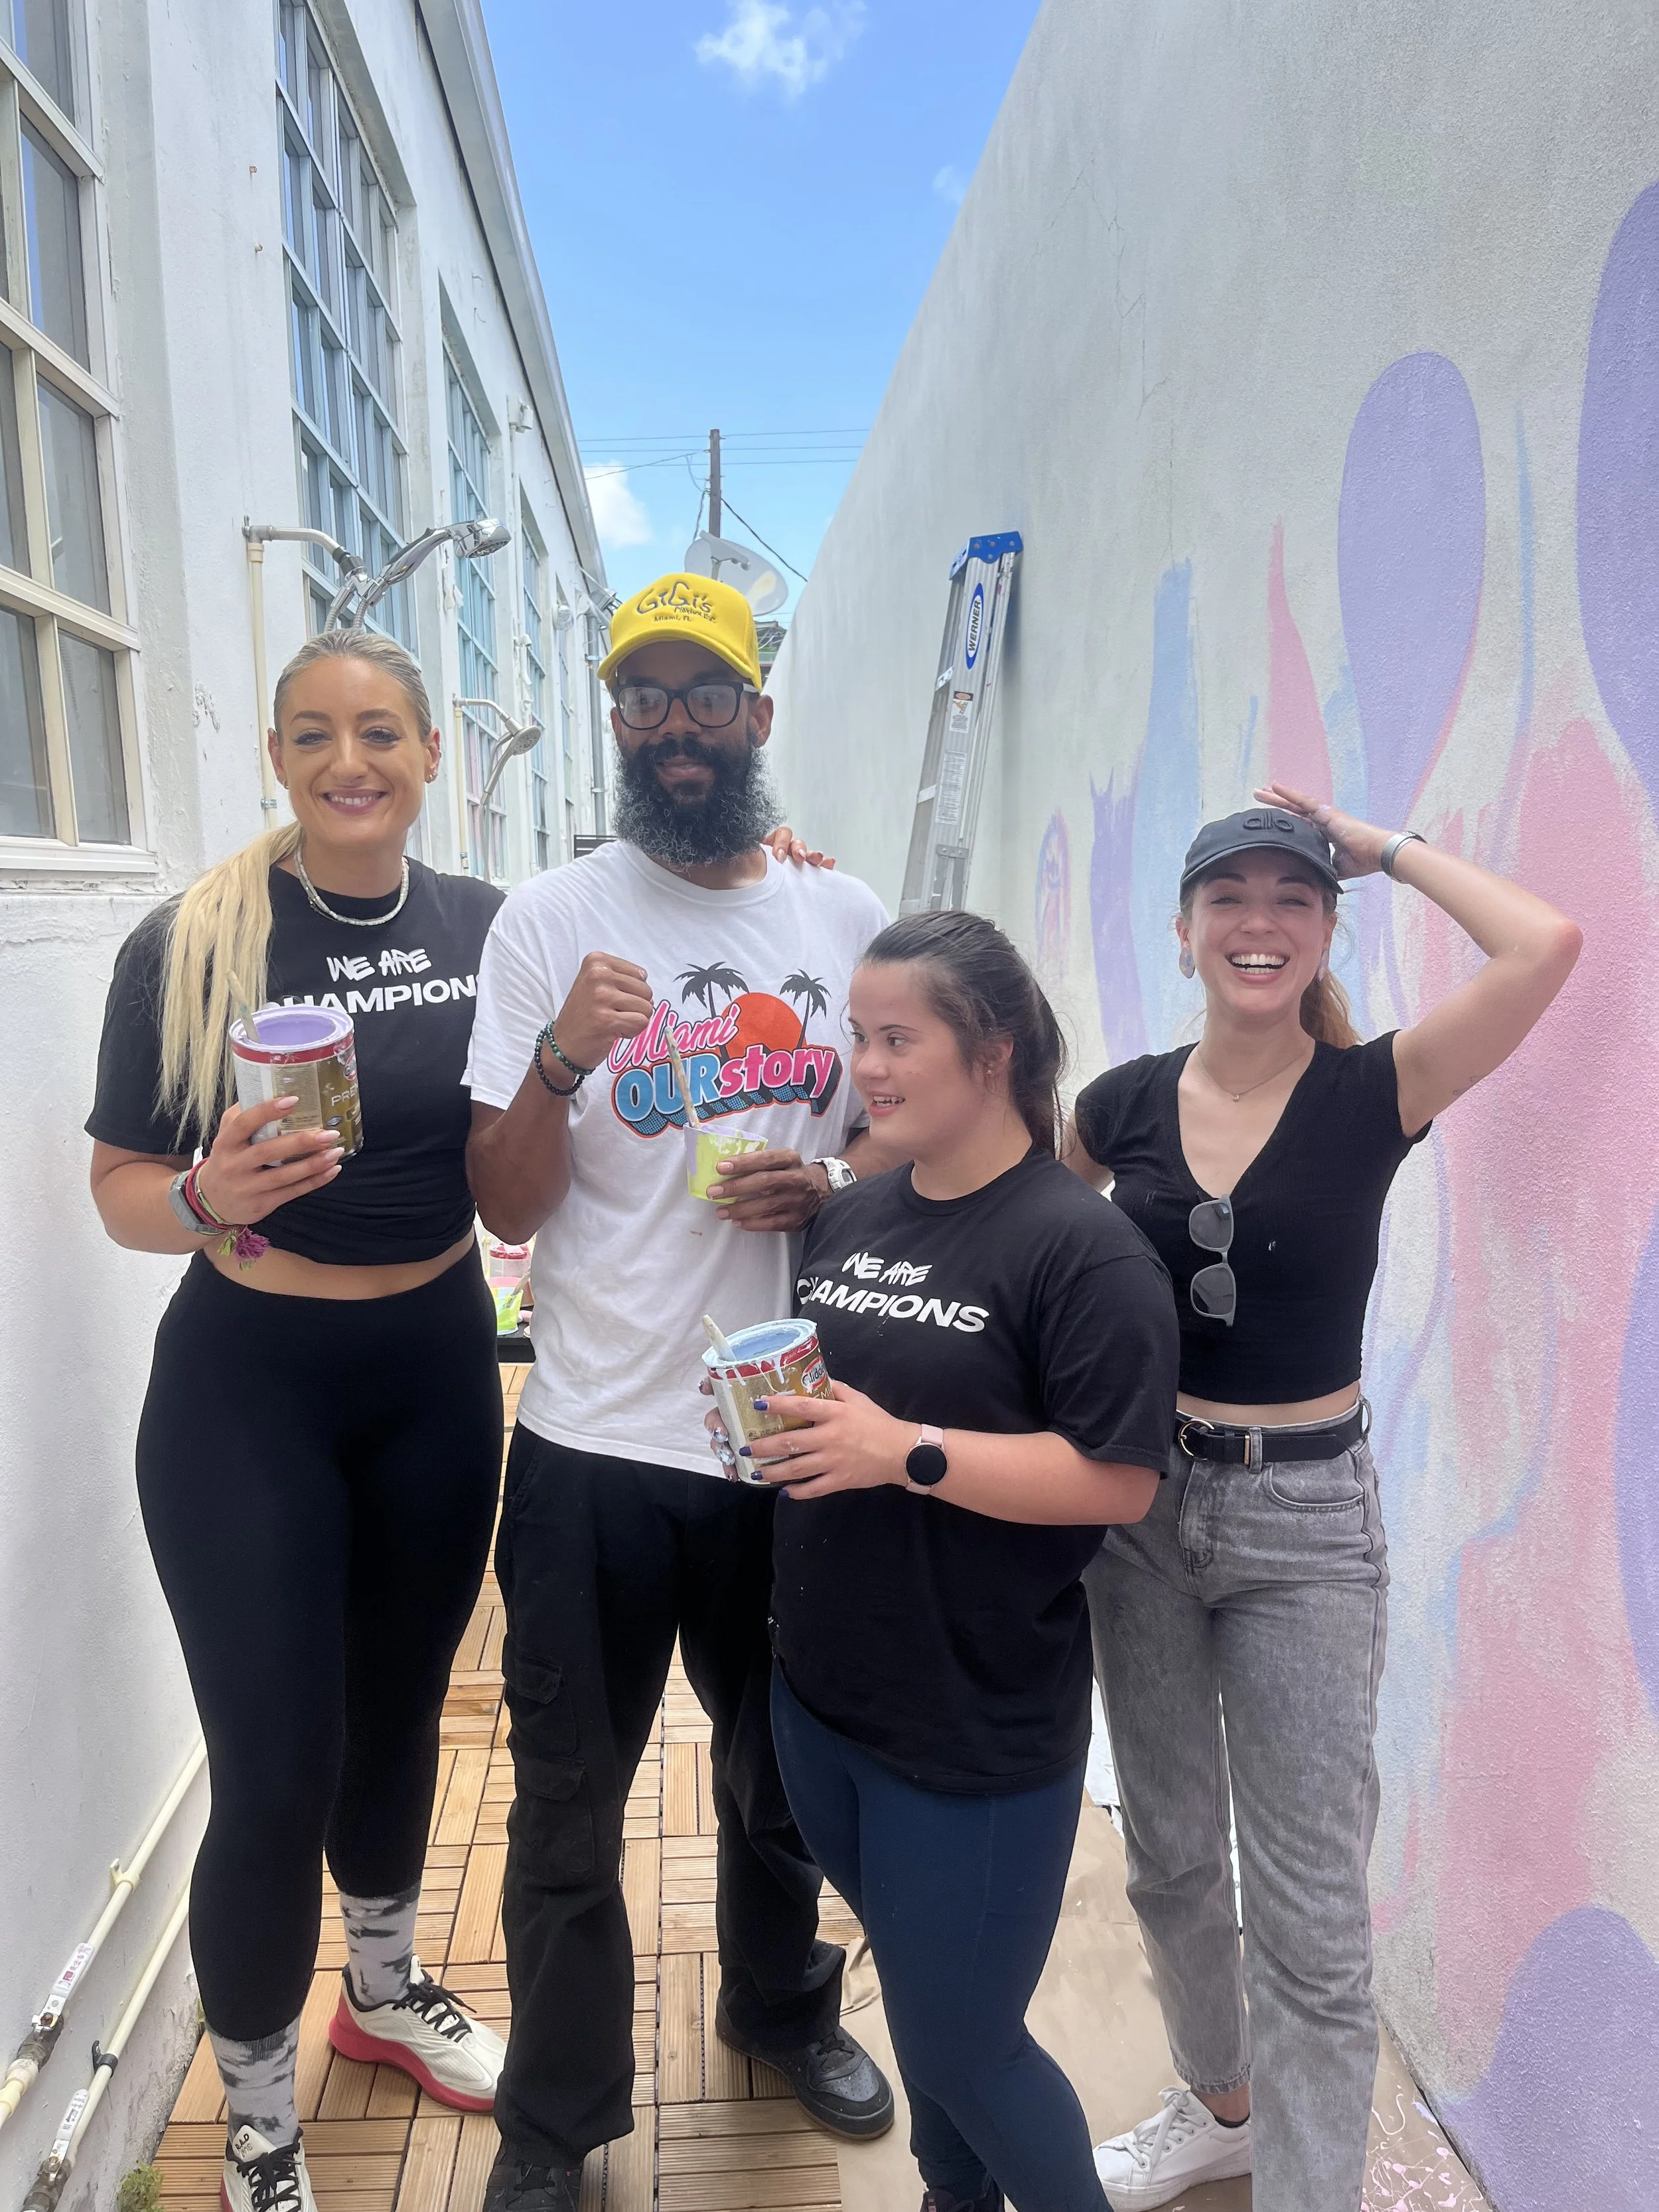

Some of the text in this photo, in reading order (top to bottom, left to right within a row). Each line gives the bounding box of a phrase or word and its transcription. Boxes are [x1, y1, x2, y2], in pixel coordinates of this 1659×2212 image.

[968, 600, 981, 651] WERNER
[326, 948, 431, 982] WE ARE
[262, 974, 478, 1013] AMPION
[841, 1252, 933, 1286] WE ARE
